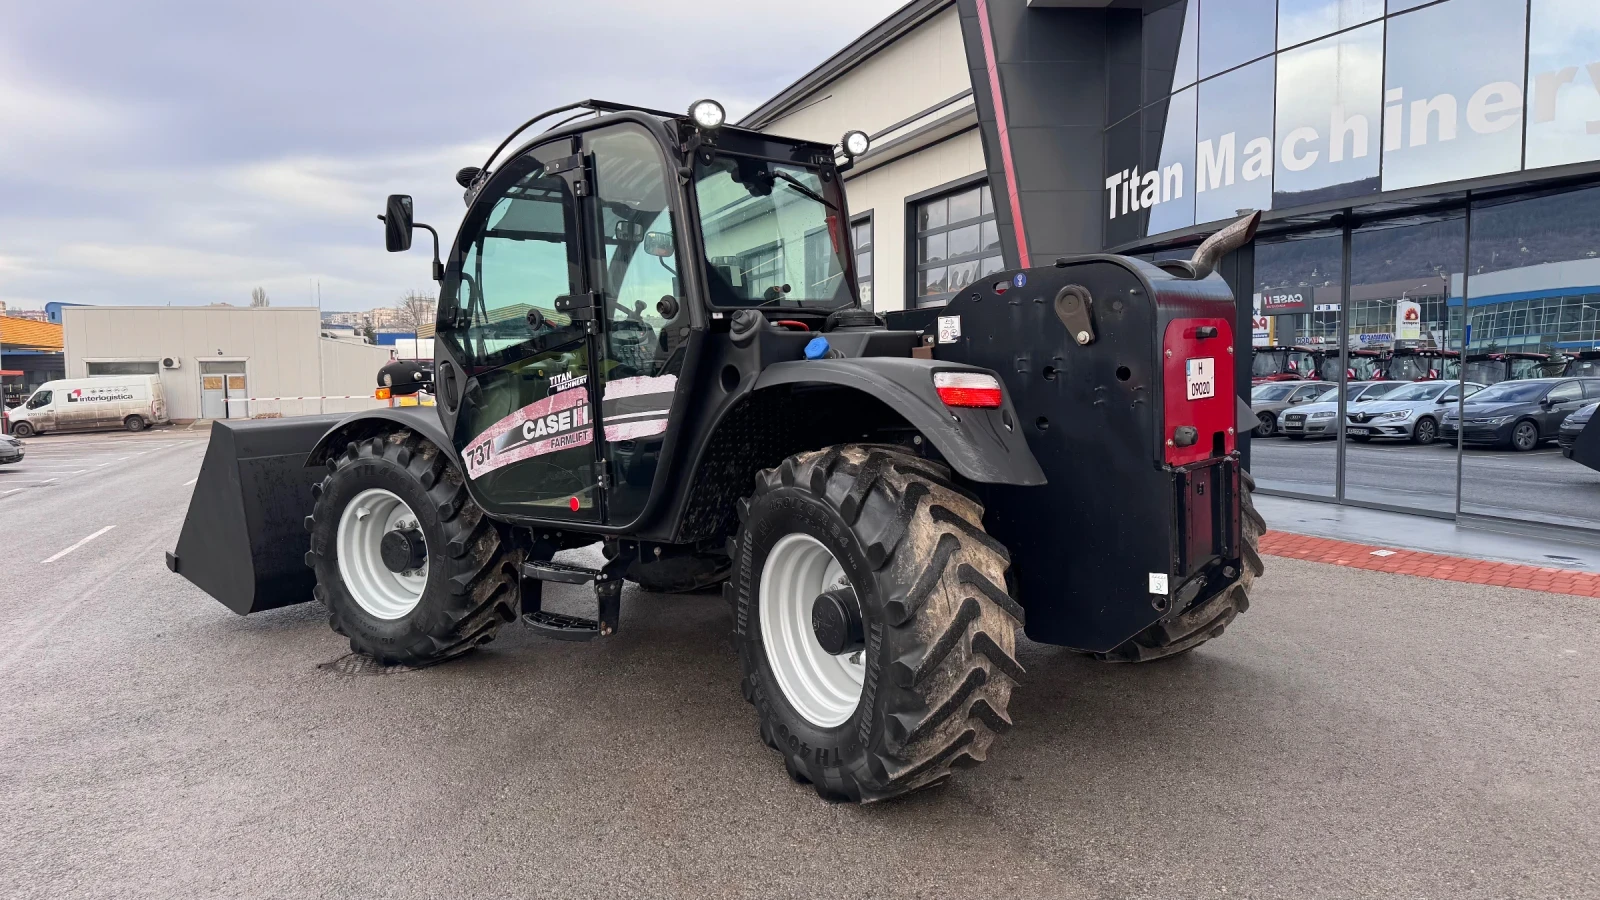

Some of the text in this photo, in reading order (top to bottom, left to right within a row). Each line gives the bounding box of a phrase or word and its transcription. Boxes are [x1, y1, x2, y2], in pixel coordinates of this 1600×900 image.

[1106, 162, 1183, 219] Titan
[1198, 361, 1203, 376] H
[549, 371, 572, 385] TITAN
[556, 377, 587, 392] MACHINERY
[1191, 381, 1211, 397] 09020
[80, 394, 133, 402] interlogistica
[522, 410, 571, 440] CASE
[550, 430, 588, 449] FARMLIFT
[466, 438, 492, 471] 737
